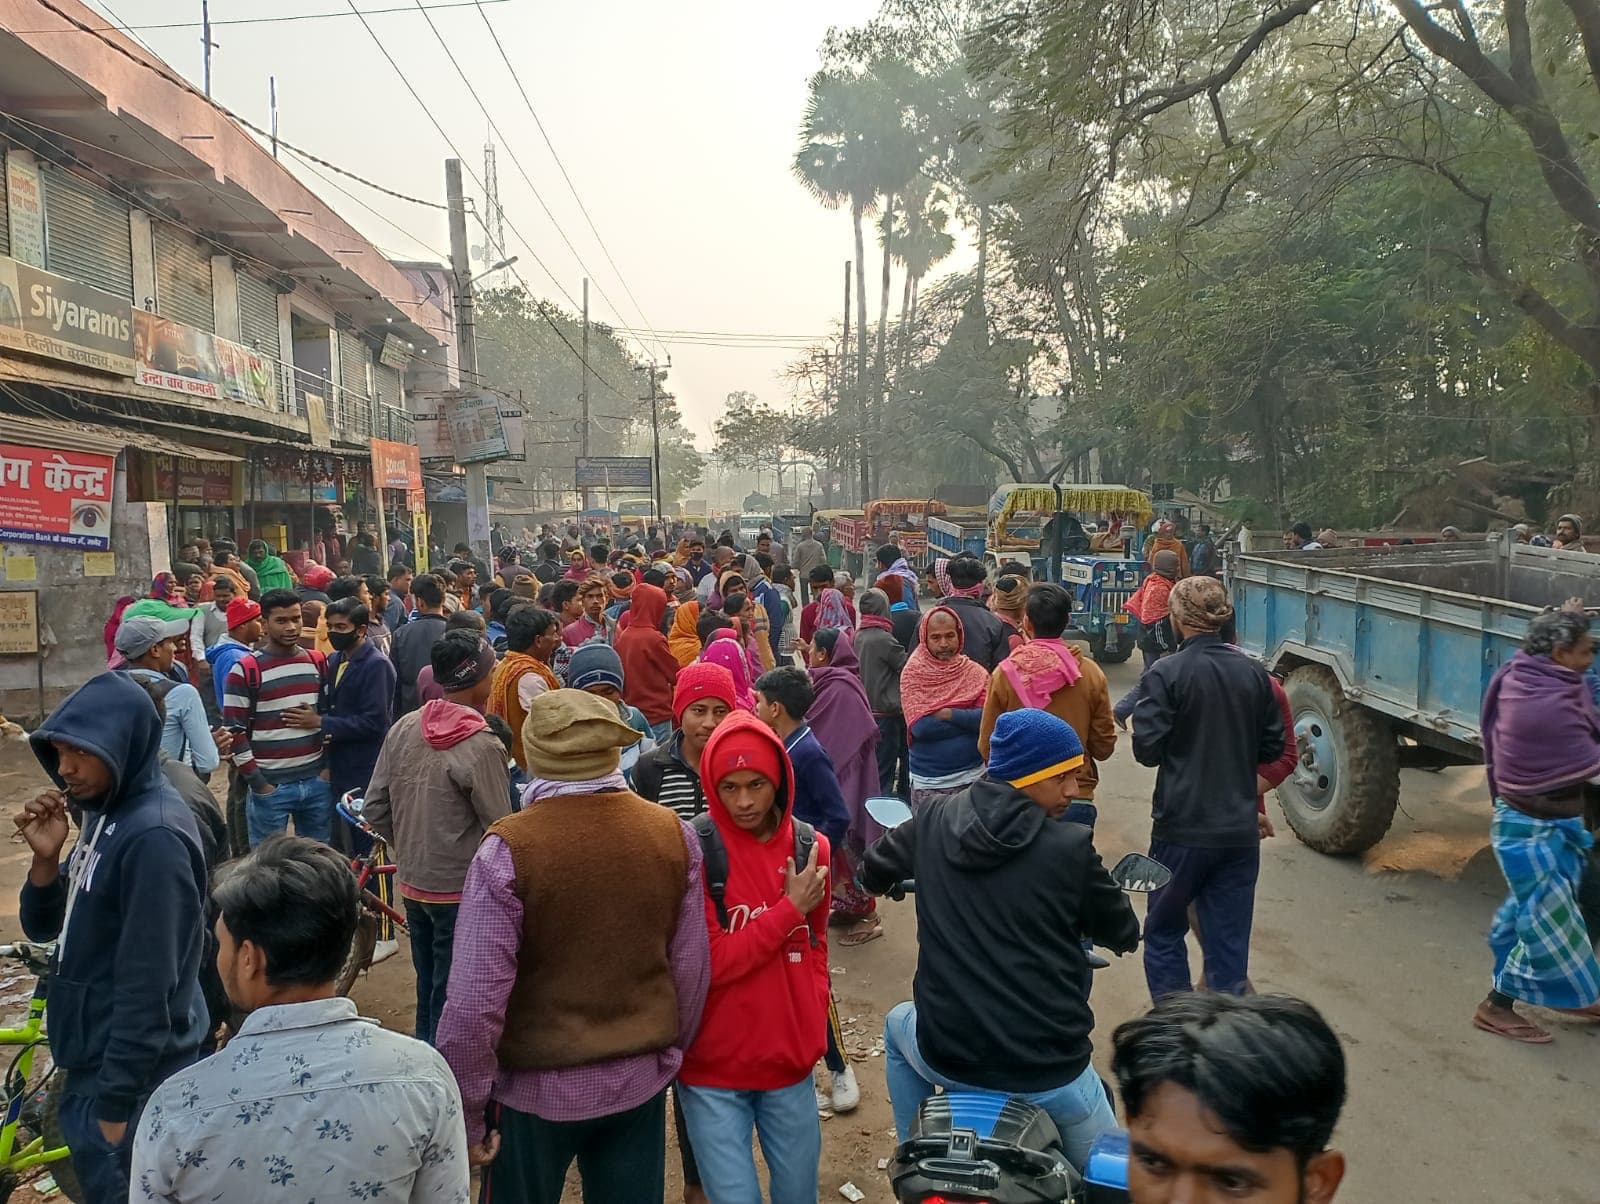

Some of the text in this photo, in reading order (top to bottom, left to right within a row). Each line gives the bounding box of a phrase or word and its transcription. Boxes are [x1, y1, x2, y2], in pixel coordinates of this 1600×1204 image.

[30, 284, 130, 341] Siyarams
[24, 332, 63, 356] दिलीप
[42, 454, 108, 496] केन्द्र
[35, 532, 51, 541] Bank
